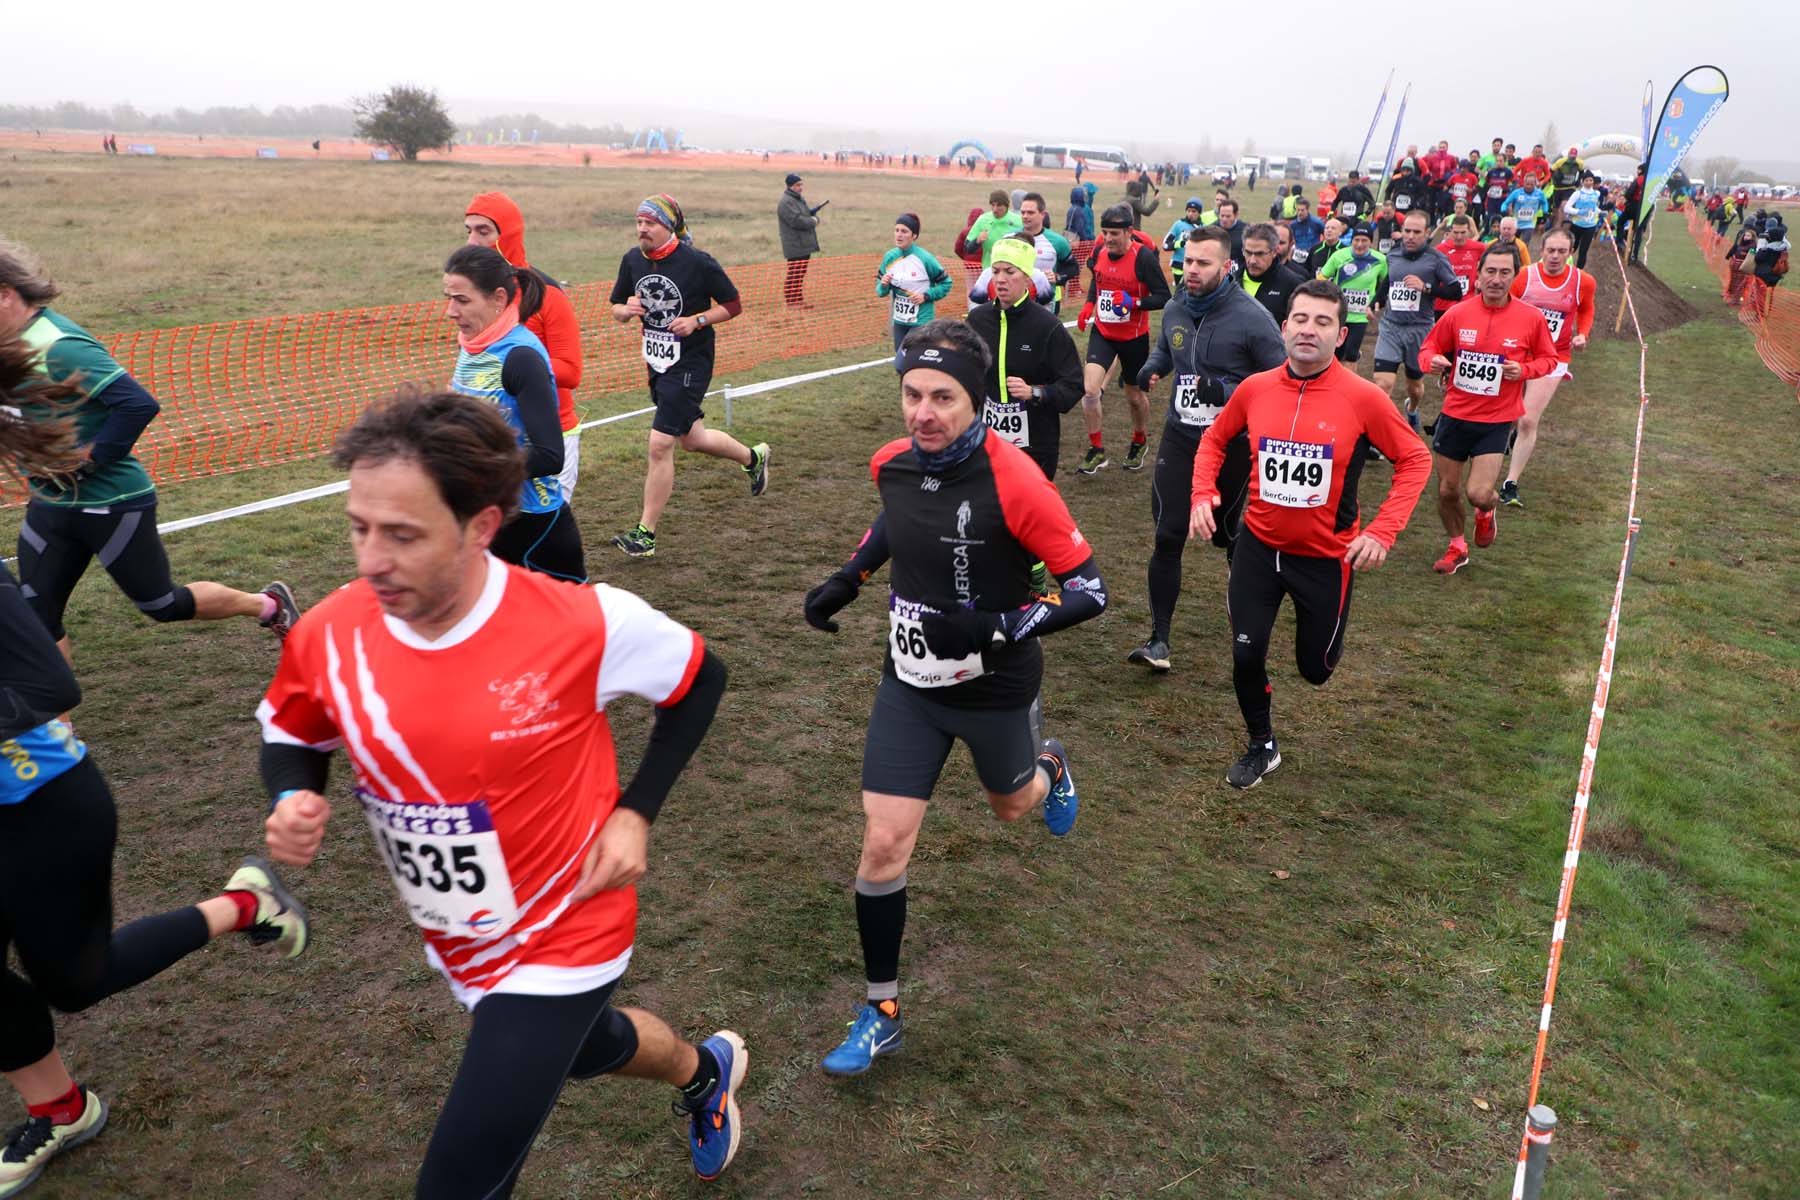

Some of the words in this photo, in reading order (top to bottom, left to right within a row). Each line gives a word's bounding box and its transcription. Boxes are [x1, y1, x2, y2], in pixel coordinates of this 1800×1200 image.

[1391, 289, 1417, 302] 6296
[1546, 318, 1559, 333] 73
[646, 341, 675, 360] 6034
[1460, 350, 1500, 359] DIPUTACIÓN
[1459, 362, 1497, 381] 6549
[986, 410, 1022, 433] 6249
[1265, 446, 1324, 459] BURGOS
[1266, 439, 1324, 452] DIPUTACIÓN
[1265, 457, 1323, 487] 6149
[1262, 489, 1298, 504] iberCaja
[895, 605, 920, 621] BUR
[895, 622, 927, 660] 66
